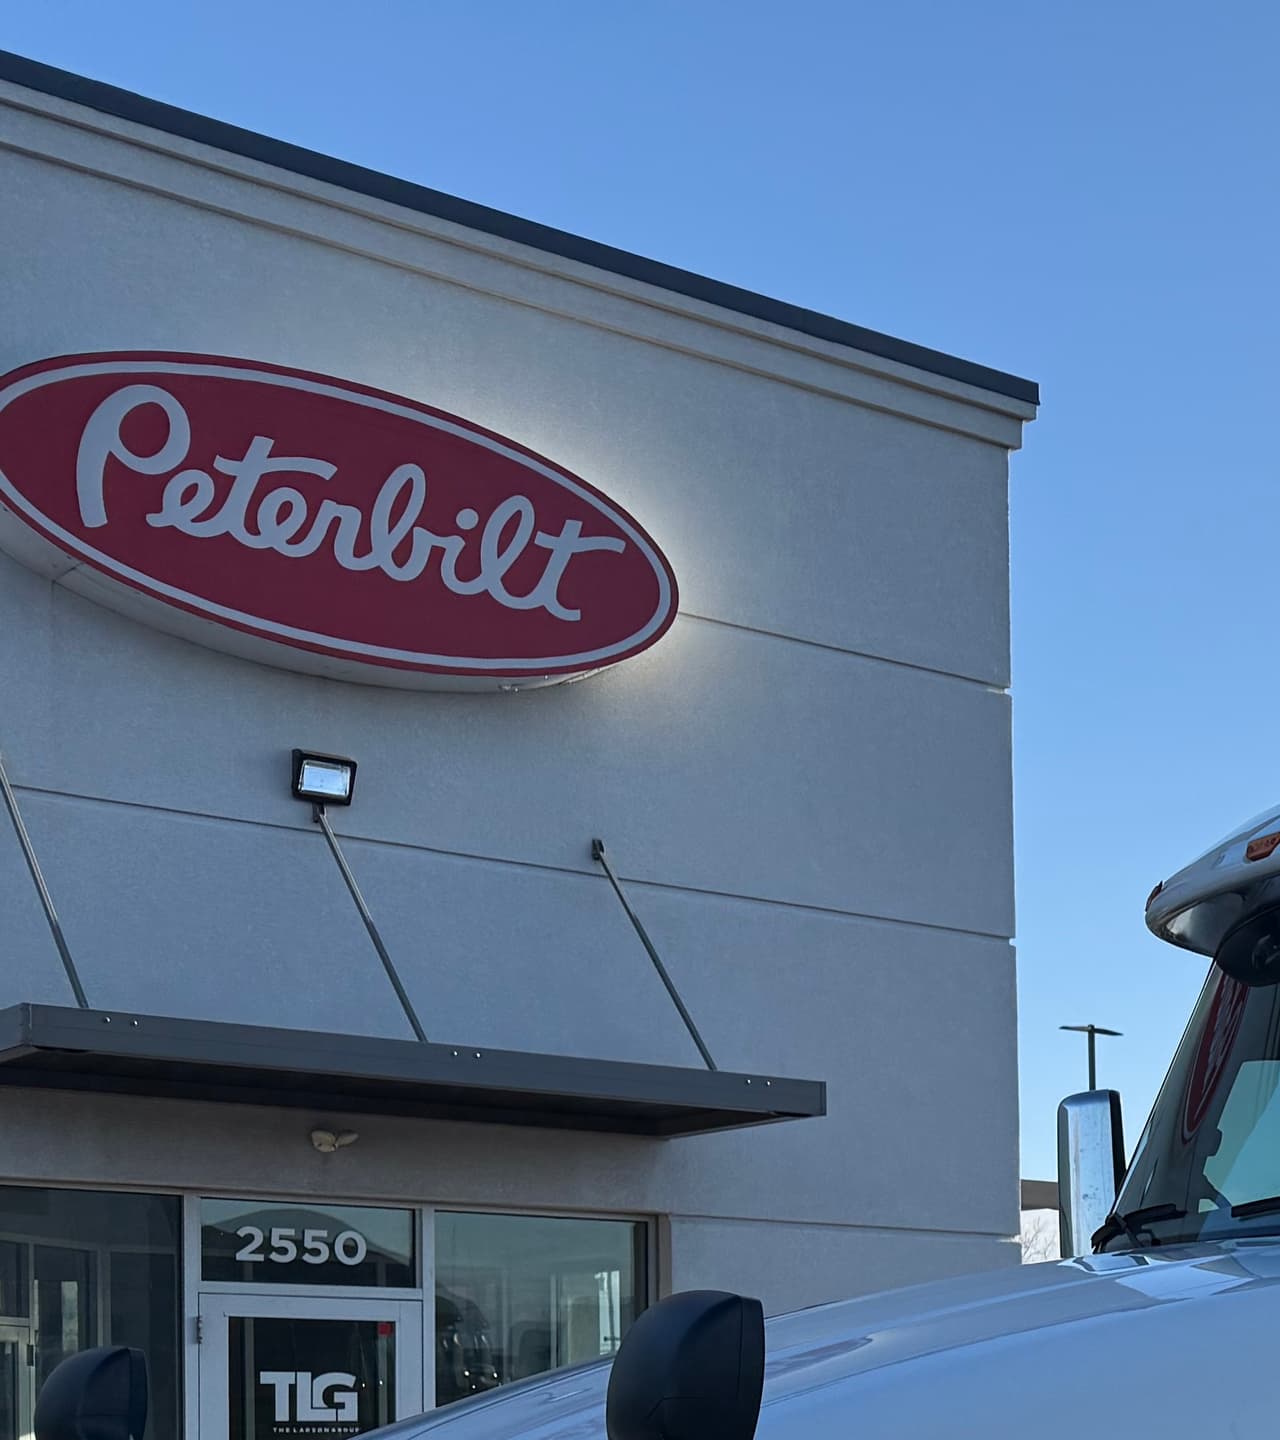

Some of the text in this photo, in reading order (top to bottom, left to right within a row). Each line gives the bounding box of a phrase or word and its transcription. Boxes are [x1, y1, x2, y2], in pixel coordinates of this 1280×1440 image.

[76, 383, 626, 622] Peterbilt
[235, 1225, 367, 1266] 2550
[260, 1371, 358, 1422] TLG
